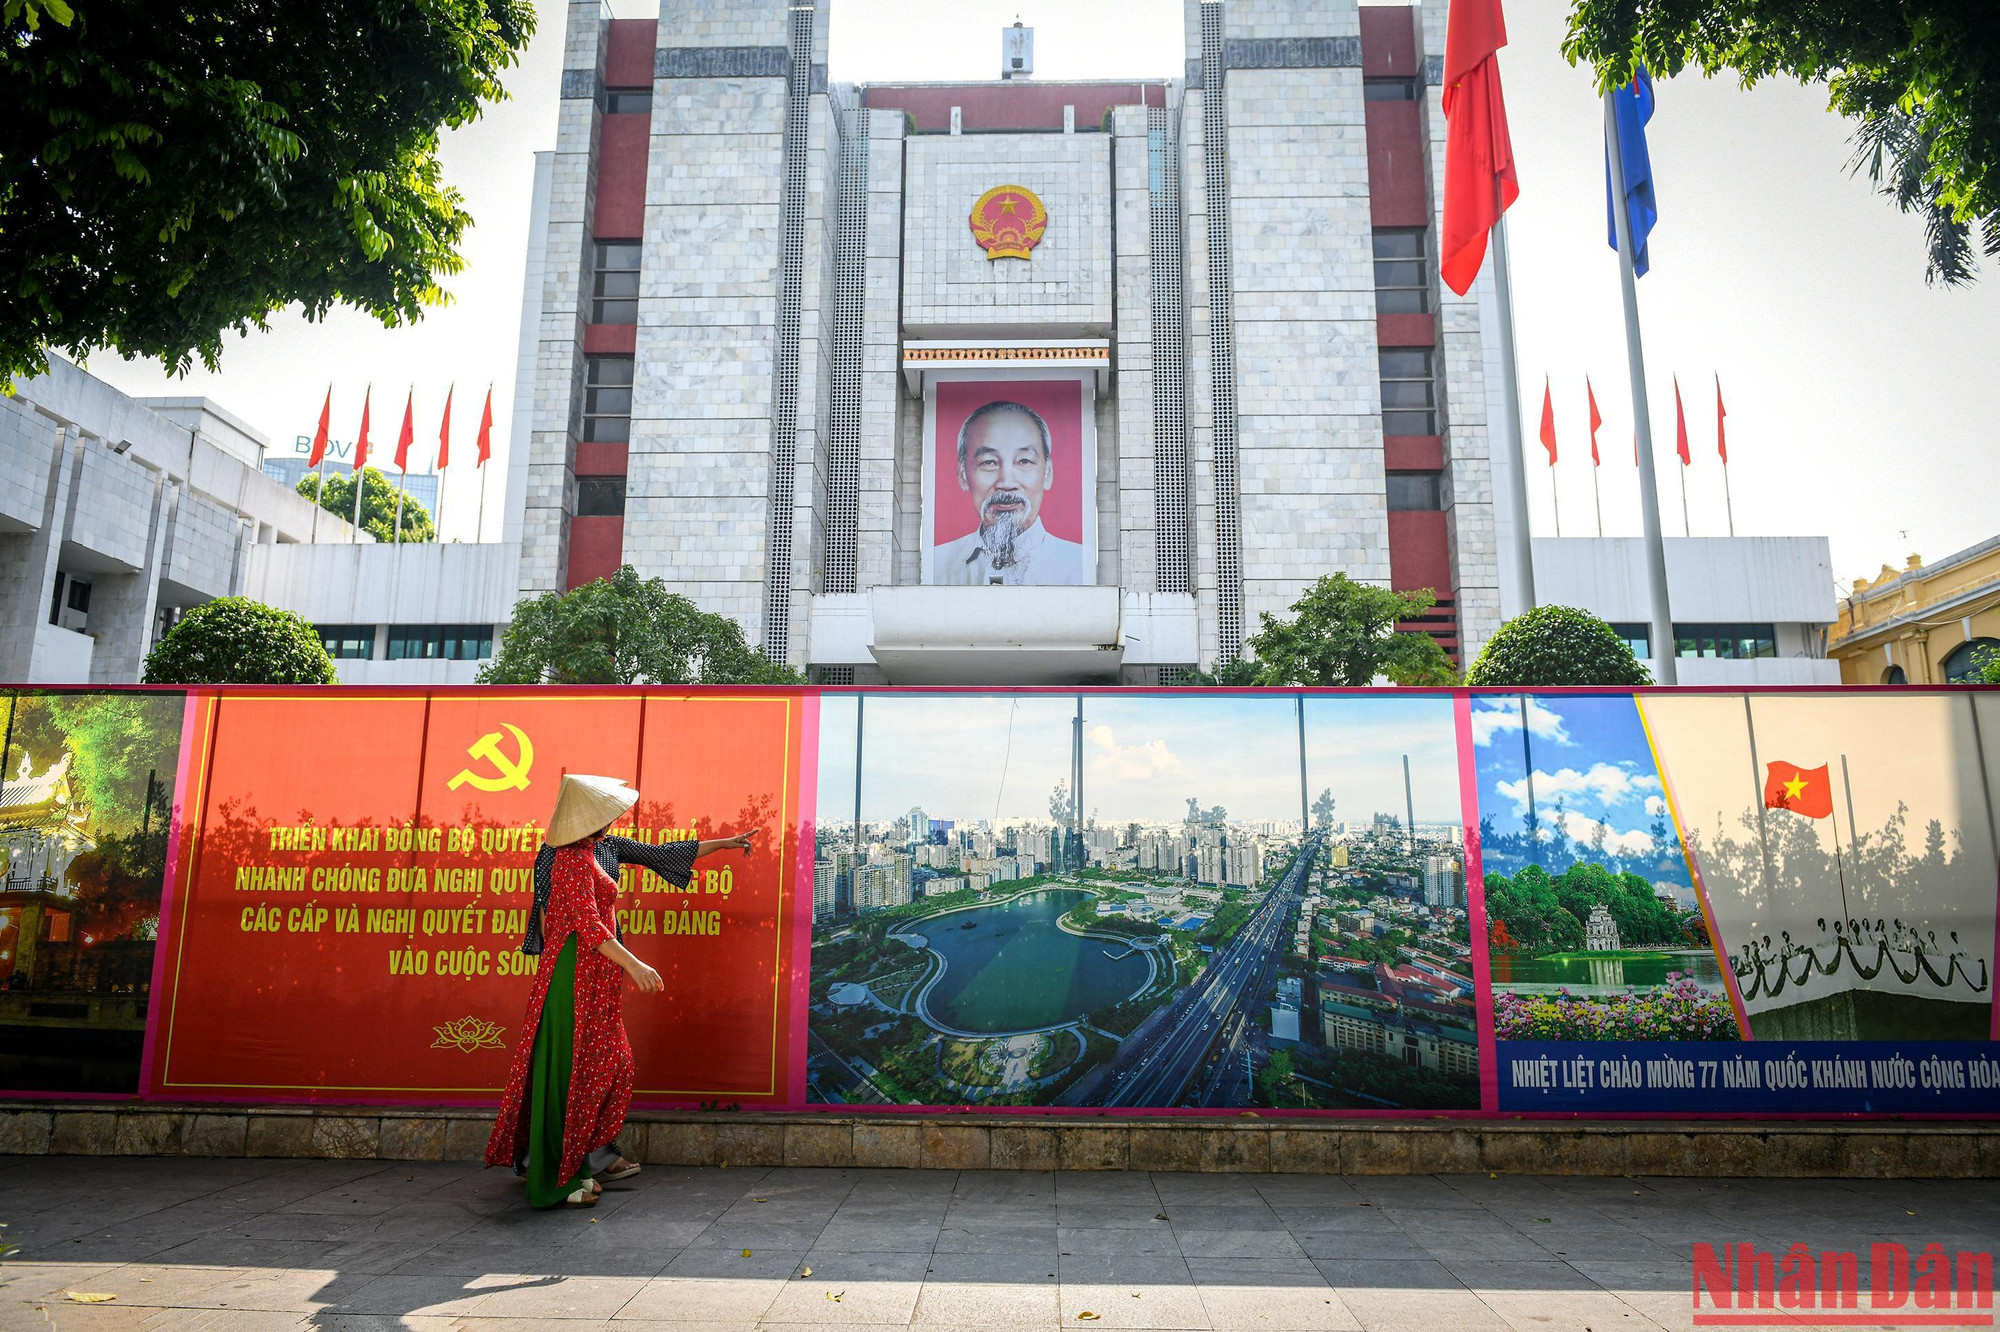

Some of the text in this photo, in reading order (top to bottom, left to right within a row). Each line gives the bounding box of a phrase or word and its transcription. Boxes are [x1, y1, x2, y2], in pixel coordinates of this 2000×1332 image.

[270, 818, 327, 851] TRIỂN
[332, 827, 380, 852] KHAI
[385, 819, 442, 852] ĐỒNG
[447, 823, 475, 858] BỘ
[481, 819, 546, 855] QUYẾT
[235, 866, 306, 891] NHANH
[311, 863, 382, 893] CHÓNG
[386, 866, 428, 893] ĐƯA
[434, 868, 484, 898] NGHỊ
[705, 864, 733, 900] BỘ
[240, 899, 720, 940] CÁC CẤP VÀ NGHỊ QUYẾT ĐẠI CỦA ĐẢNG
[389, 945, 428, 976] VÀO
[435, 945, 491, 981] CUỘC
[1511, 1053, 1558, 1094] NHIỆT
[1562, 1053, 1595, 1094] LIỆT
[1600, 1054, 1642, 1089] CHÀO
[1646, 1053, 1696, 1089] MỪNG
[1698, 1060, 1718, 1088] 77
[1723, 1054, 1761, 1089] NĂM
[1765, 1050, 1808, 1092] QUỐC
[1811, 1054, 1868, 1089] KHÁNH
[1870, 1052, 1916, 1089] NƯỚC
[1919, 1054, 1966, 1095] CỘNG
